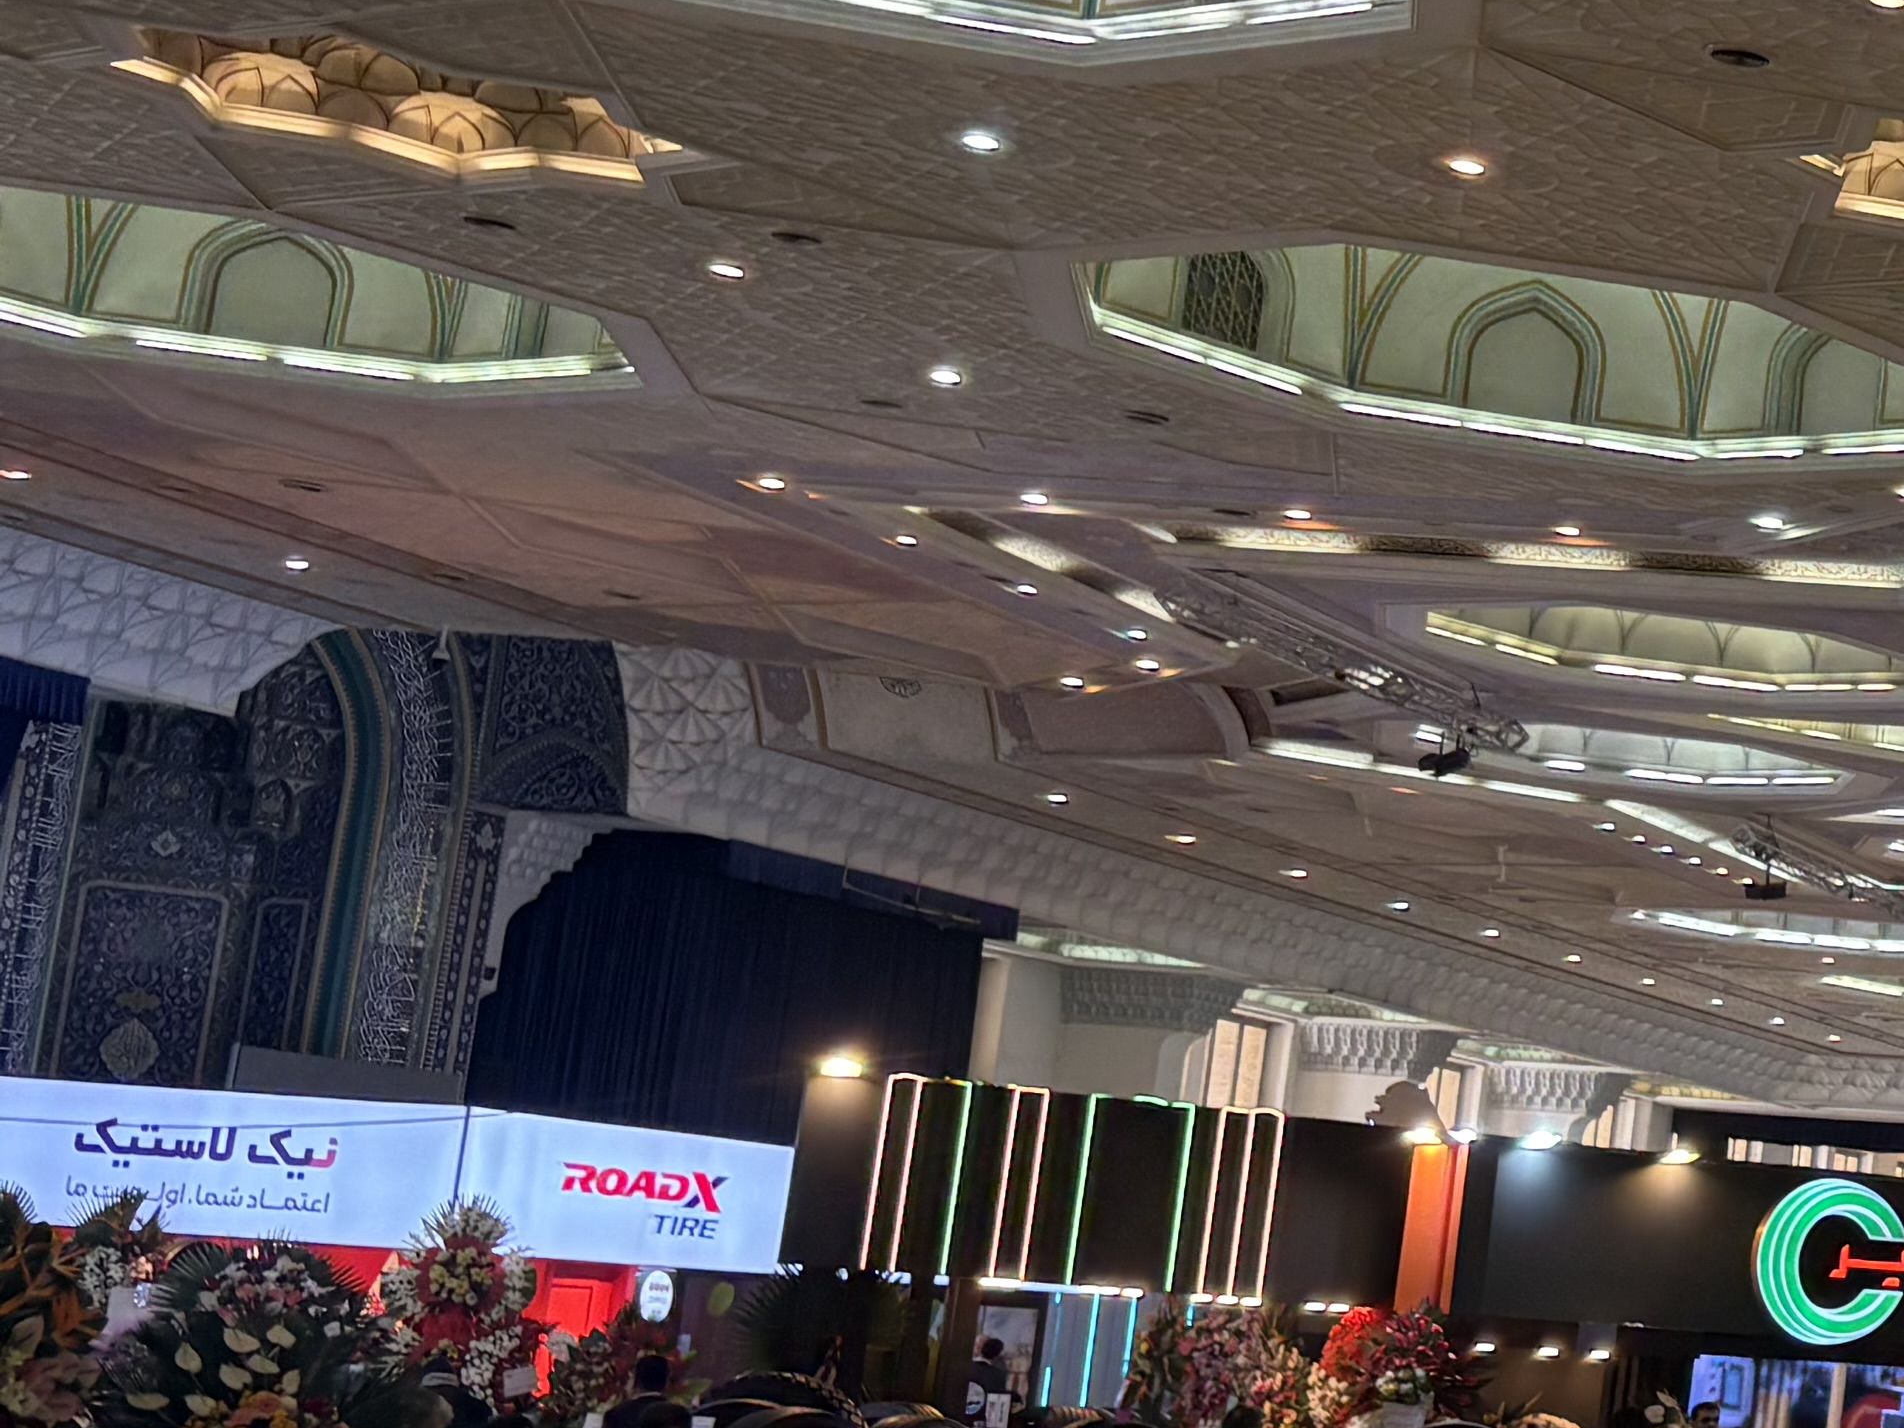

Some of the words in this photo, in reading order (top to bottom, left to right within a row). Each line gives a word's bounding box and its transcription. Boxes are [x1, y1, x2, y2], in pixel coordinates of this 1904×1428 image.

[74, 1117, 236, 1168] لاستیک
[248, 1129, 339, 1180] نیک
[560, 1162, 730, 1214] ROADX
[654, 1214, 720, 1240] TIRE
